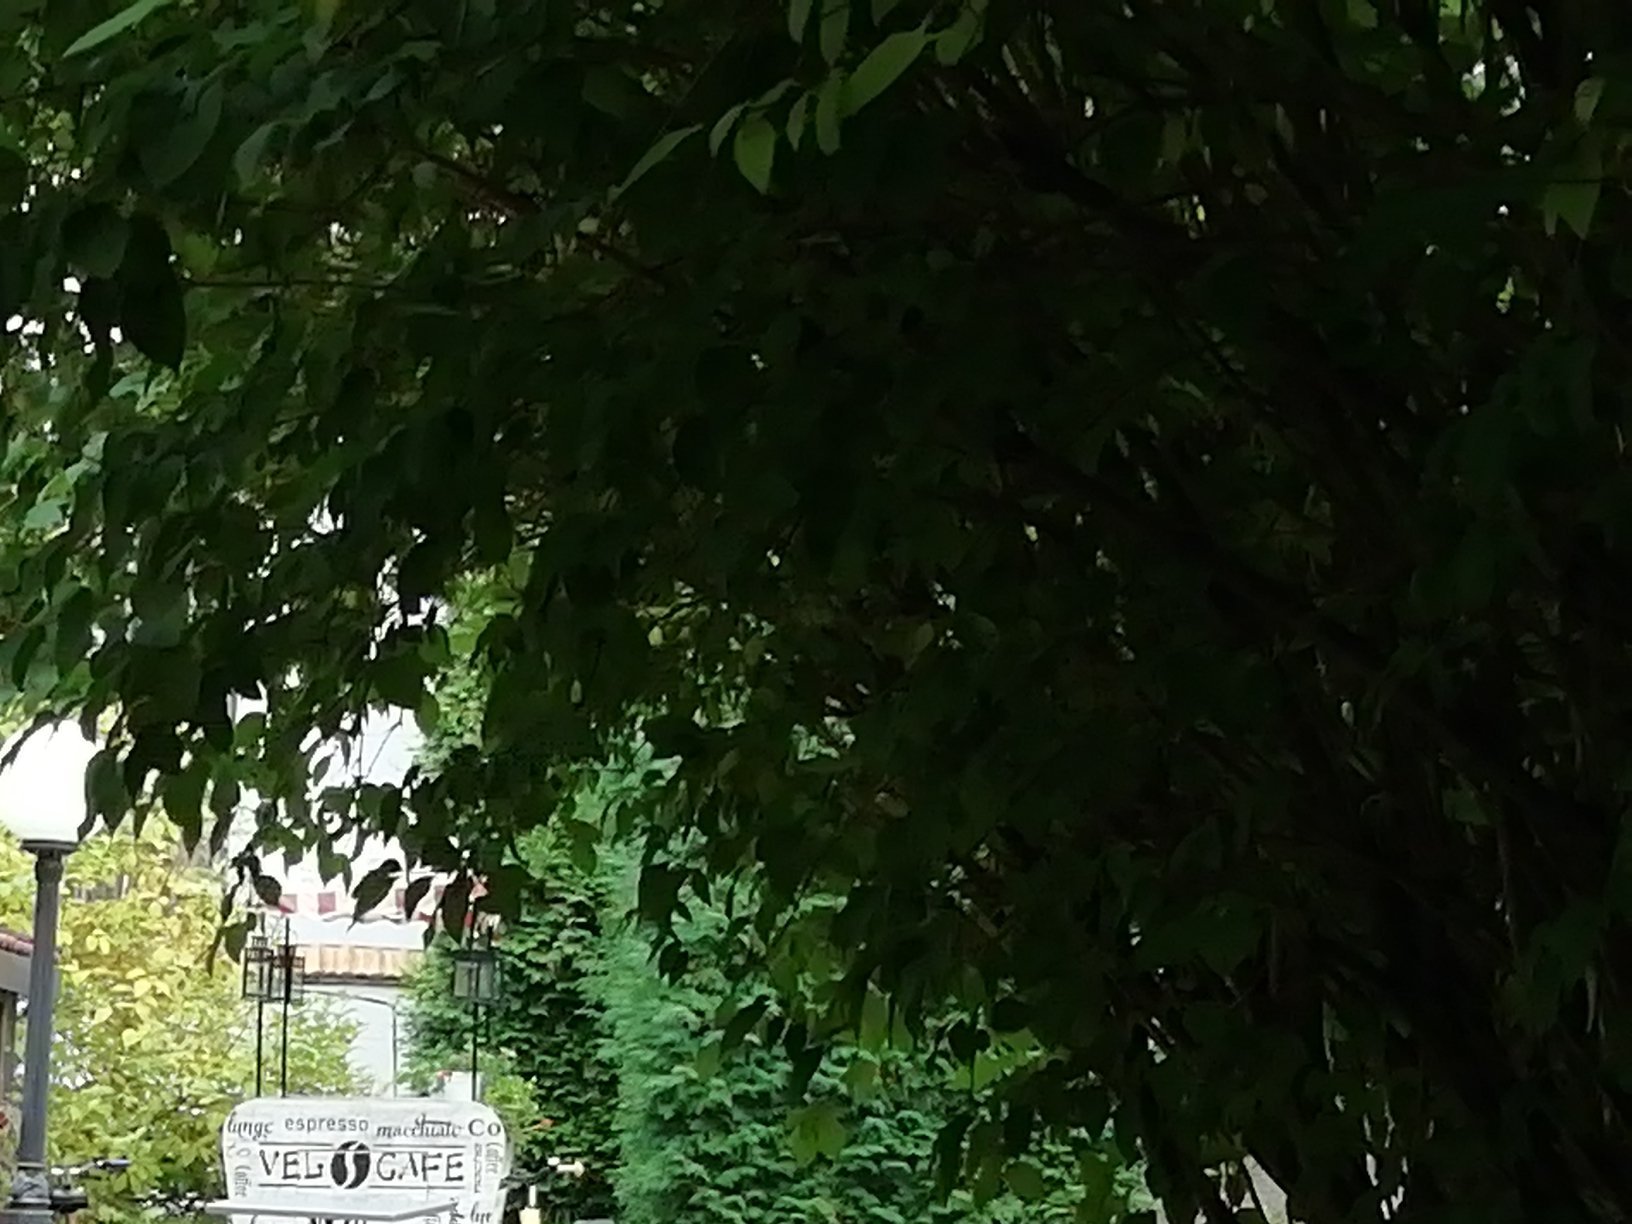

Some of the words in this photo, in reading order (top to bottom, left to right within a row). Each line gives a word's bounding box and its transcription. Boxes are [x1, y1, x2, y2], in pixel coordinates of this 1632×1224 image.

[285, 1117, 368, 1134] espresso
[375, 1113, 463, 1138] macchiato
[376, 1151, 464, 1182] CAFE
